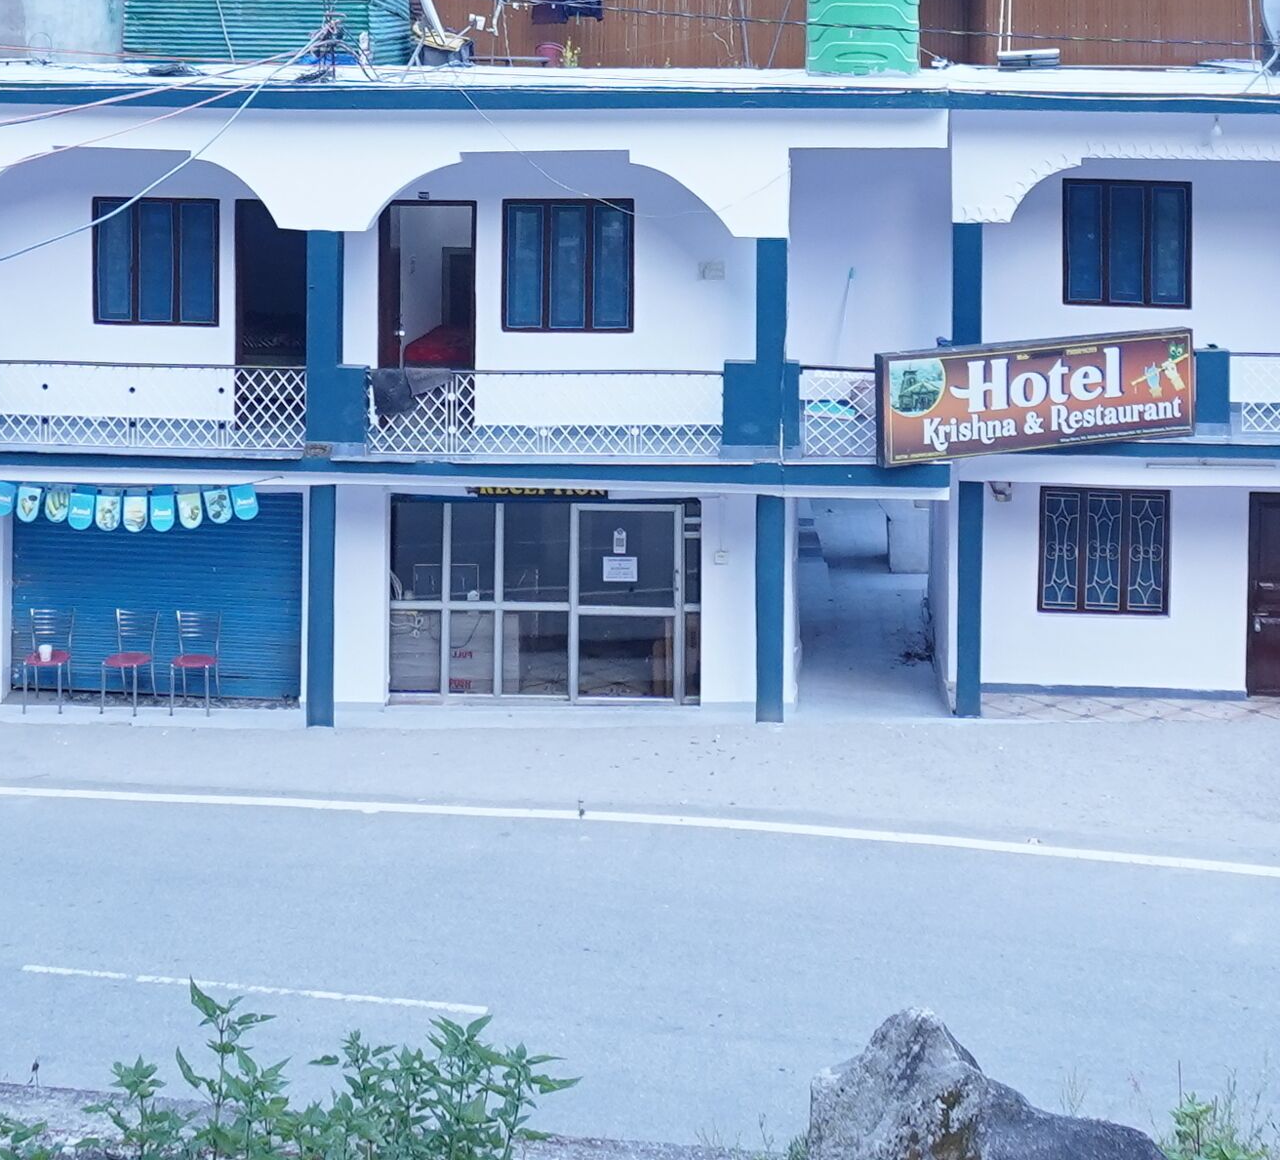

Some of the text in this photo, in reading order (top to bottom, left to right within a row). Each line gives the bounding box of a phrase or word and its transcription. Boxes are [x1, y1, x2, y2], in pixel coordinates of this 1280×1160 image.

[949, 346, 1124, 413] Hotel
[923, 414, 1018, 452] Krishna
[1024, 411, 1044, 435] &
[1050, 395, 1182, 435] Restaurant
